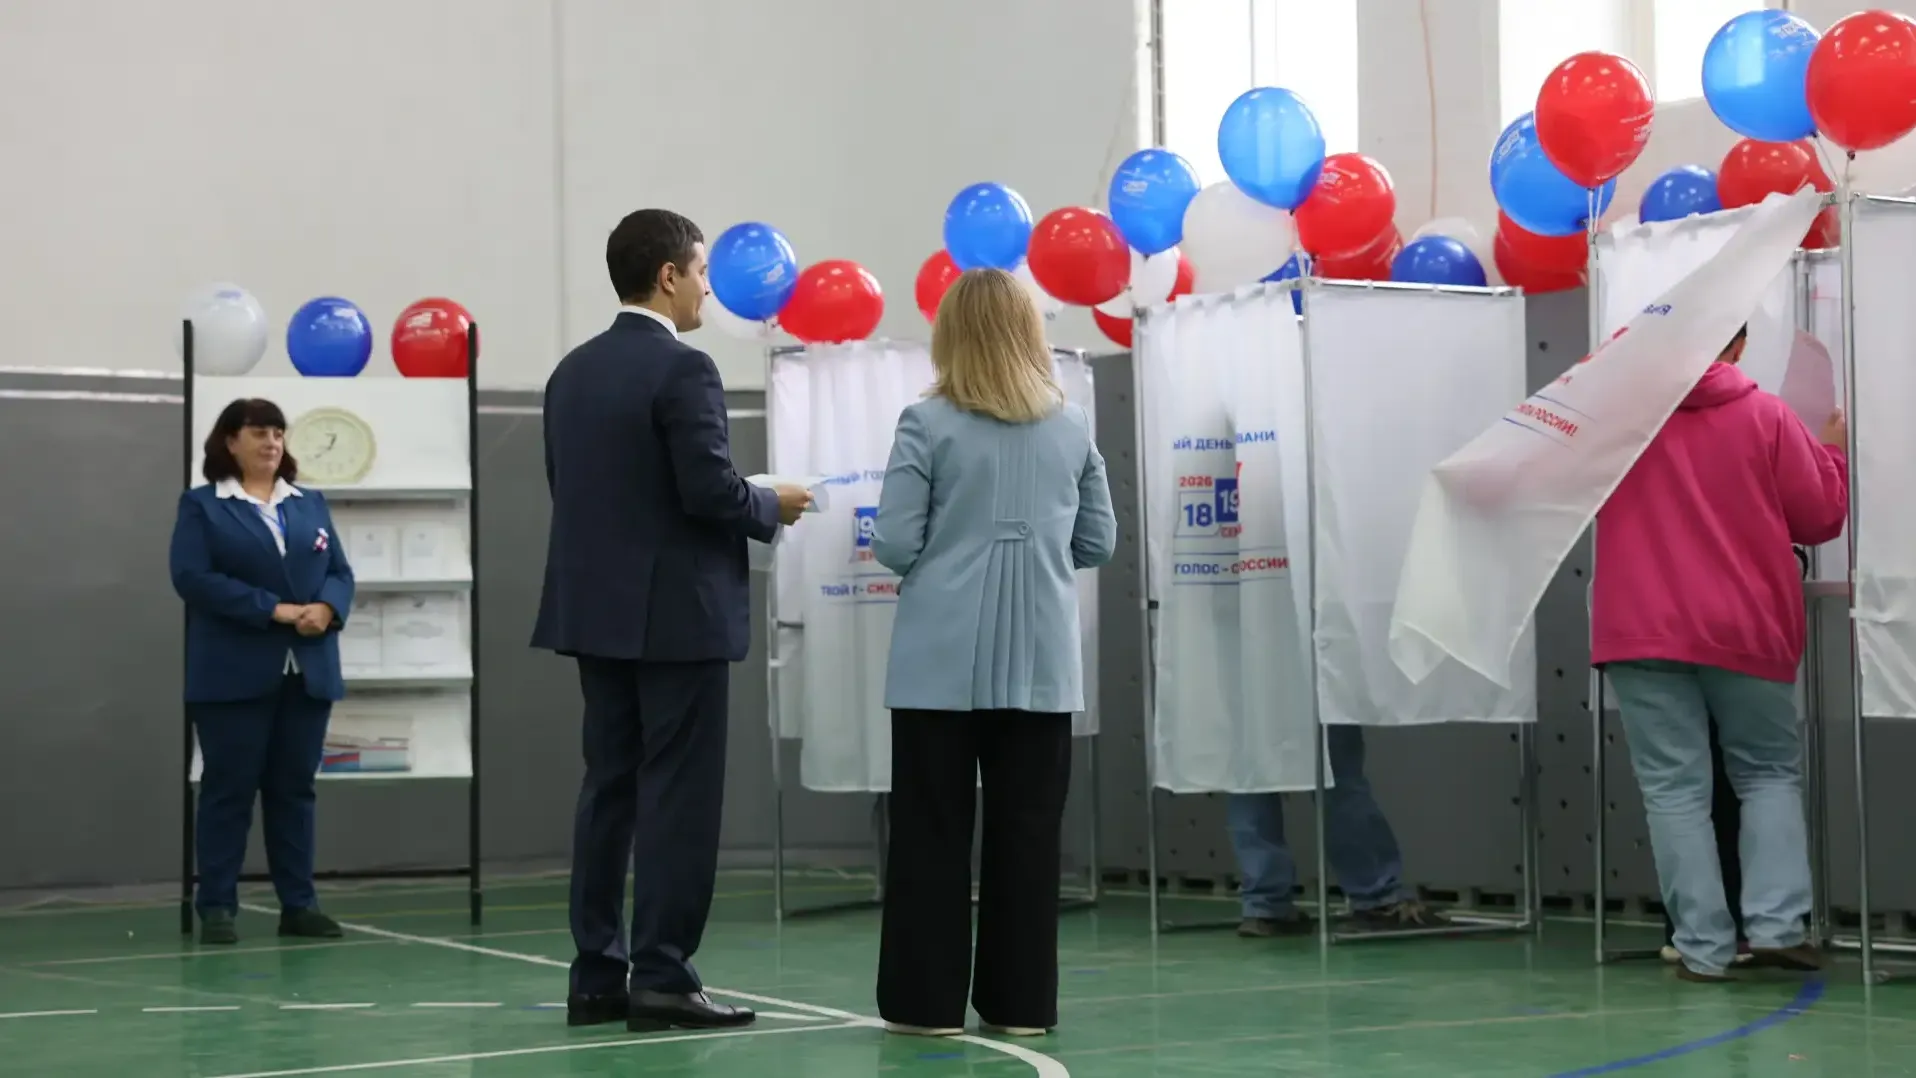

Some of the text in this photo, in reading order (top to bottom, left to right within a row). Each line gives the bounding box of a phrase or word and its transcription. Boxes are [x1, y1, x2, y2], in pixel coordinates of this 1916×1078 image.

[1195, 438, 1234, 451] ДЕНЬ
[1179, 475, 1213, 488] 2026
[1183, 502, 1214, 528] 18
[1174, 563, 1220, 575] ГОЛОС
